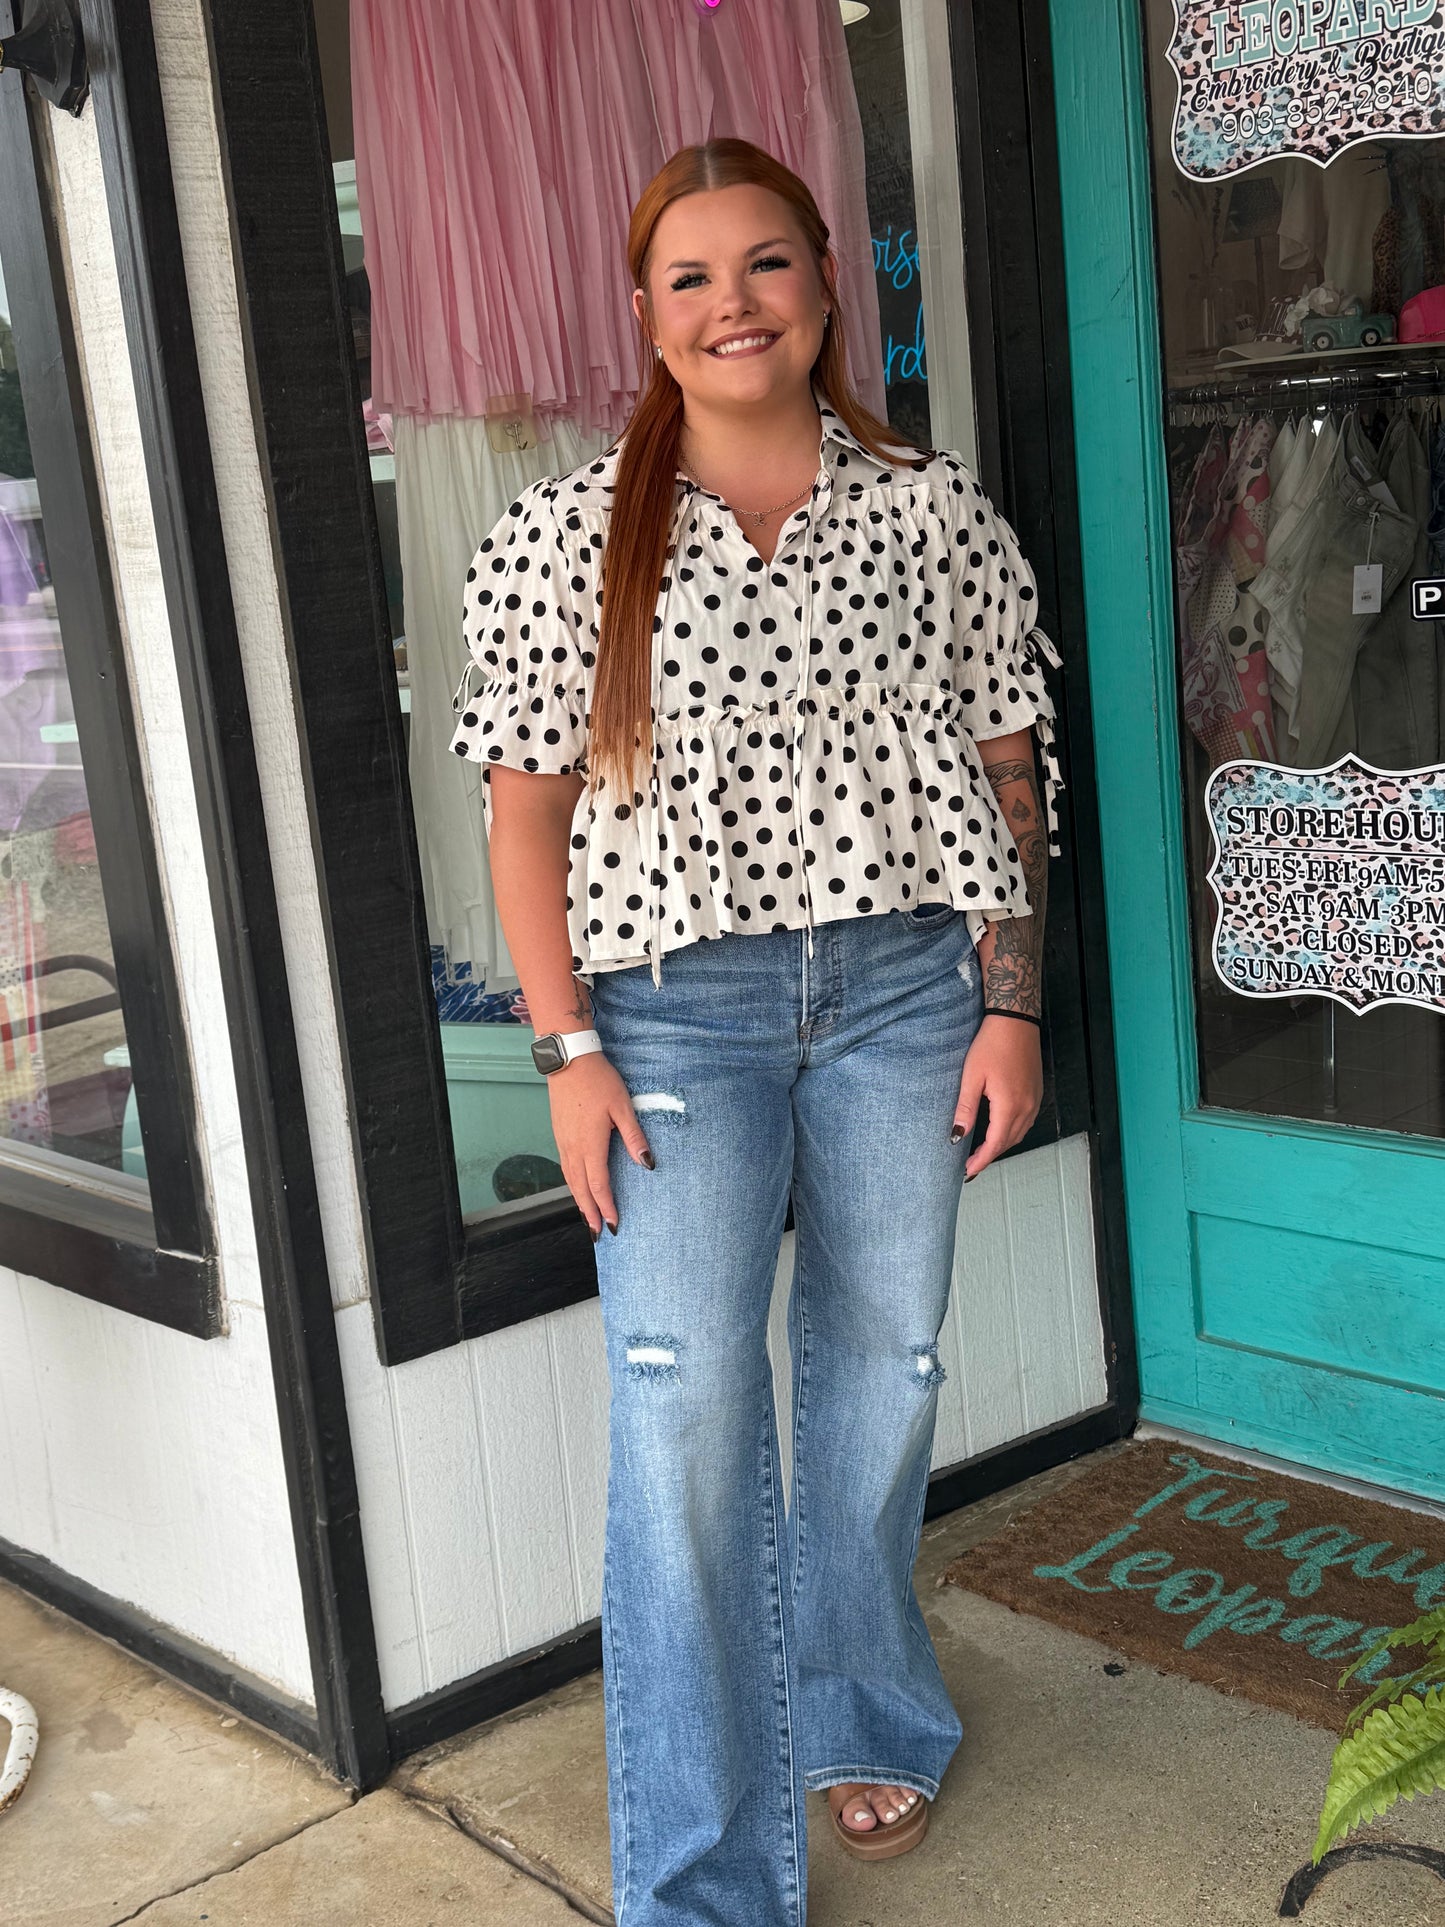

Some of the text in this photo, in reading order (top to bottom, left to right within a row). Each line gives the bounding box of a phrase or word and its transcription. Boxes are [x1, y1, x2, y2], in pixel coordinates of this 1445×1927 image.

[1209, 0, 1438, 72] LEOPARD
[1191, 58, 1321, 113] Embroidery
[1327, 49, 1350, 80] &
[1221, 70, 1433, 143] 903-852-2840
[1227, 806, 1344, 839] STORE
[1229, 856, 1351, 883] TUES-FRI
[1266, 893, 1314, 916] SAT
[1303, 930, 1412, 958] CLOSED
[1233, 957, 1336, 987] SUNDAY
[1343, 967, 1364, 990] &
